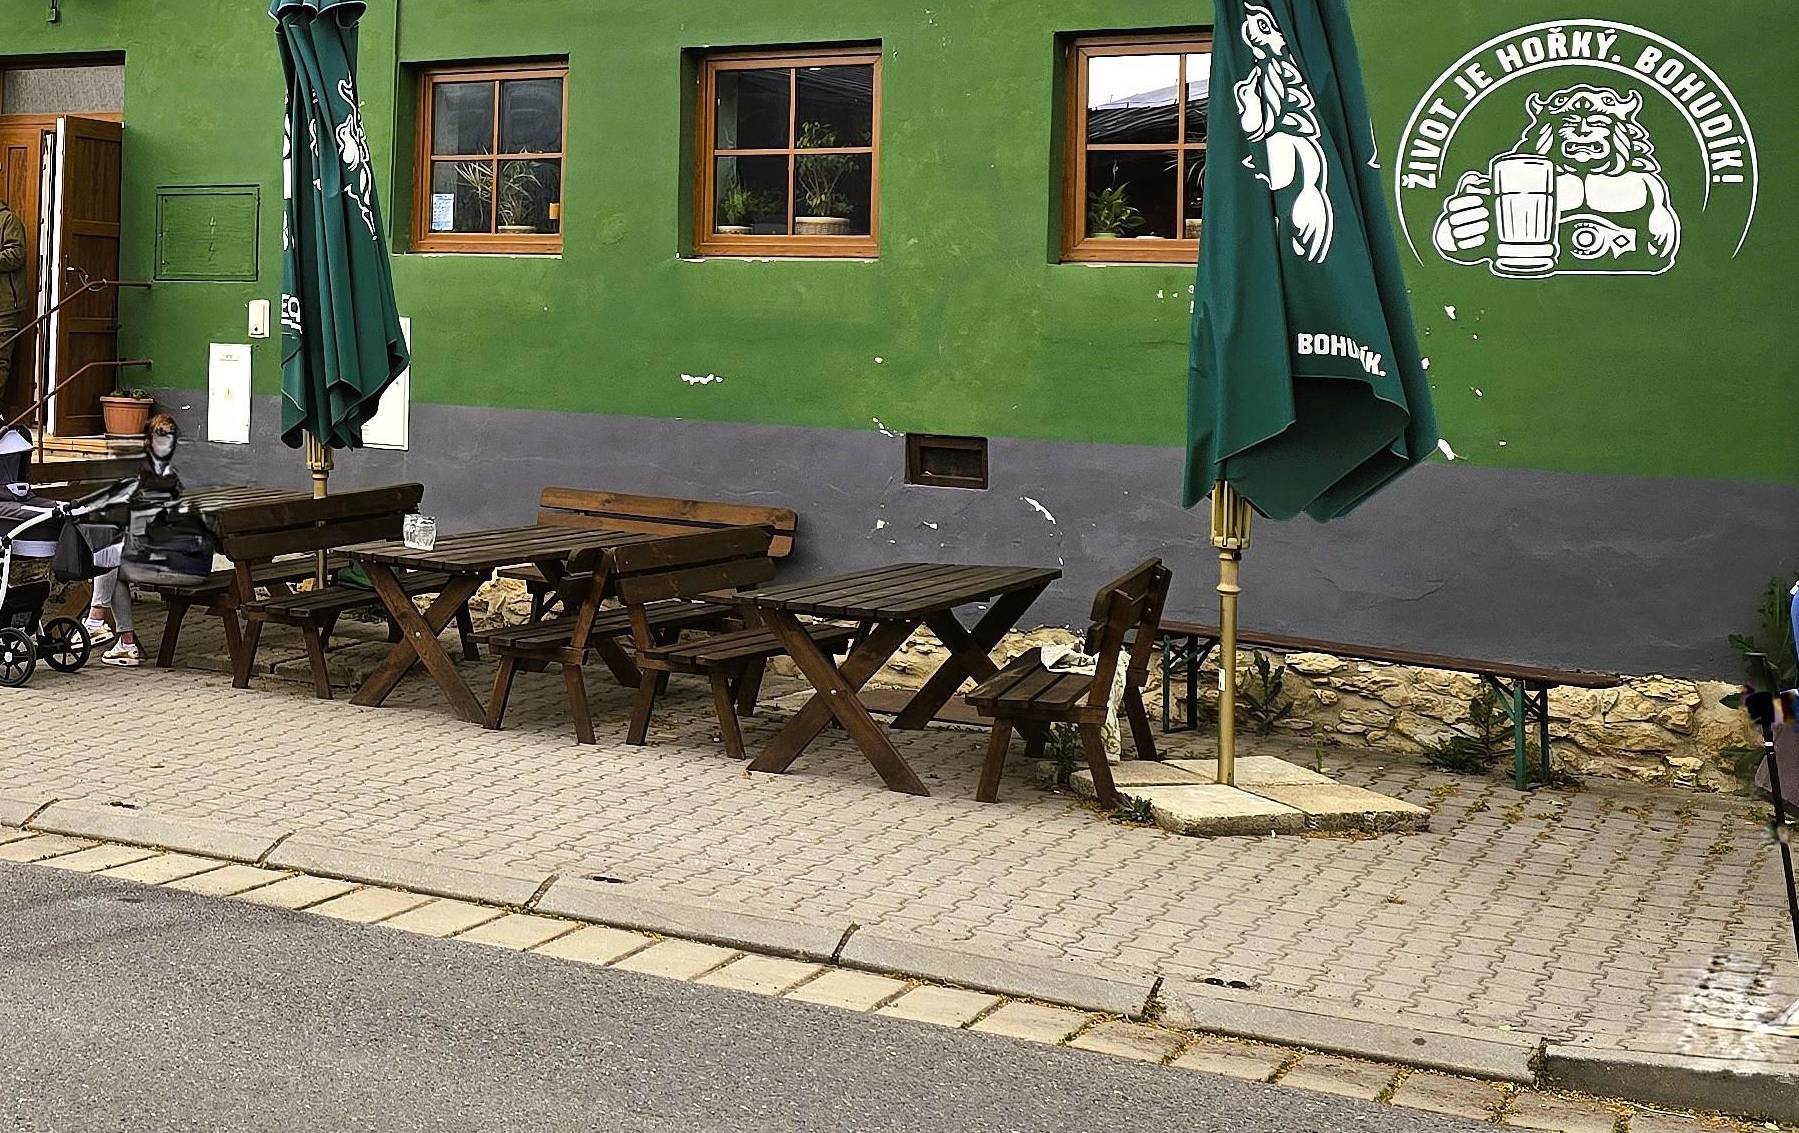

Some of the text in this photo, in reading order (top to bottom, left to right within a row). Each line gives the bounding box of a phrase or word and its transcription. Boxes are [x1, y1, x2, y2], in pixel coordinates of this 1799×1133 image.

[1402, 27, 1745, 189] ŽIVOT JE HOŘKÝ. BOHUDÍK!
